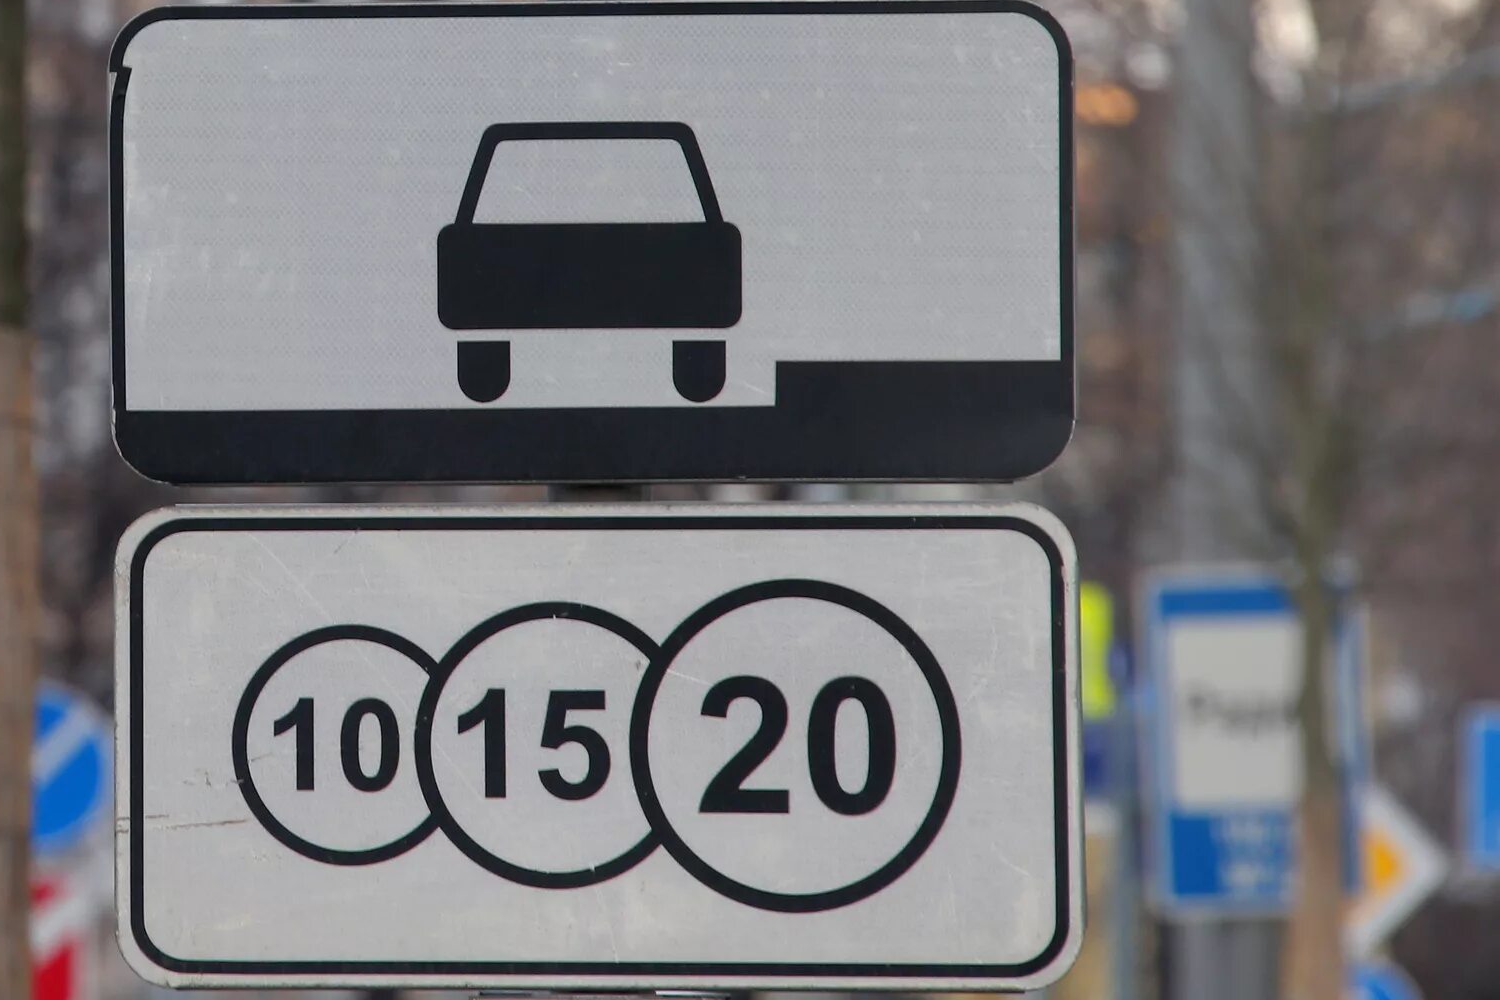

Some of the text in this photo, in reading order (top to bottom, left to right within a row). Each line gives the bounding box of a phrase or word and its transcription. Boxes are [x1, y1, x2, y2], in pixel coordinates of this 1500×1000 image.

[272, 675, 897, 816] 10 15 20
